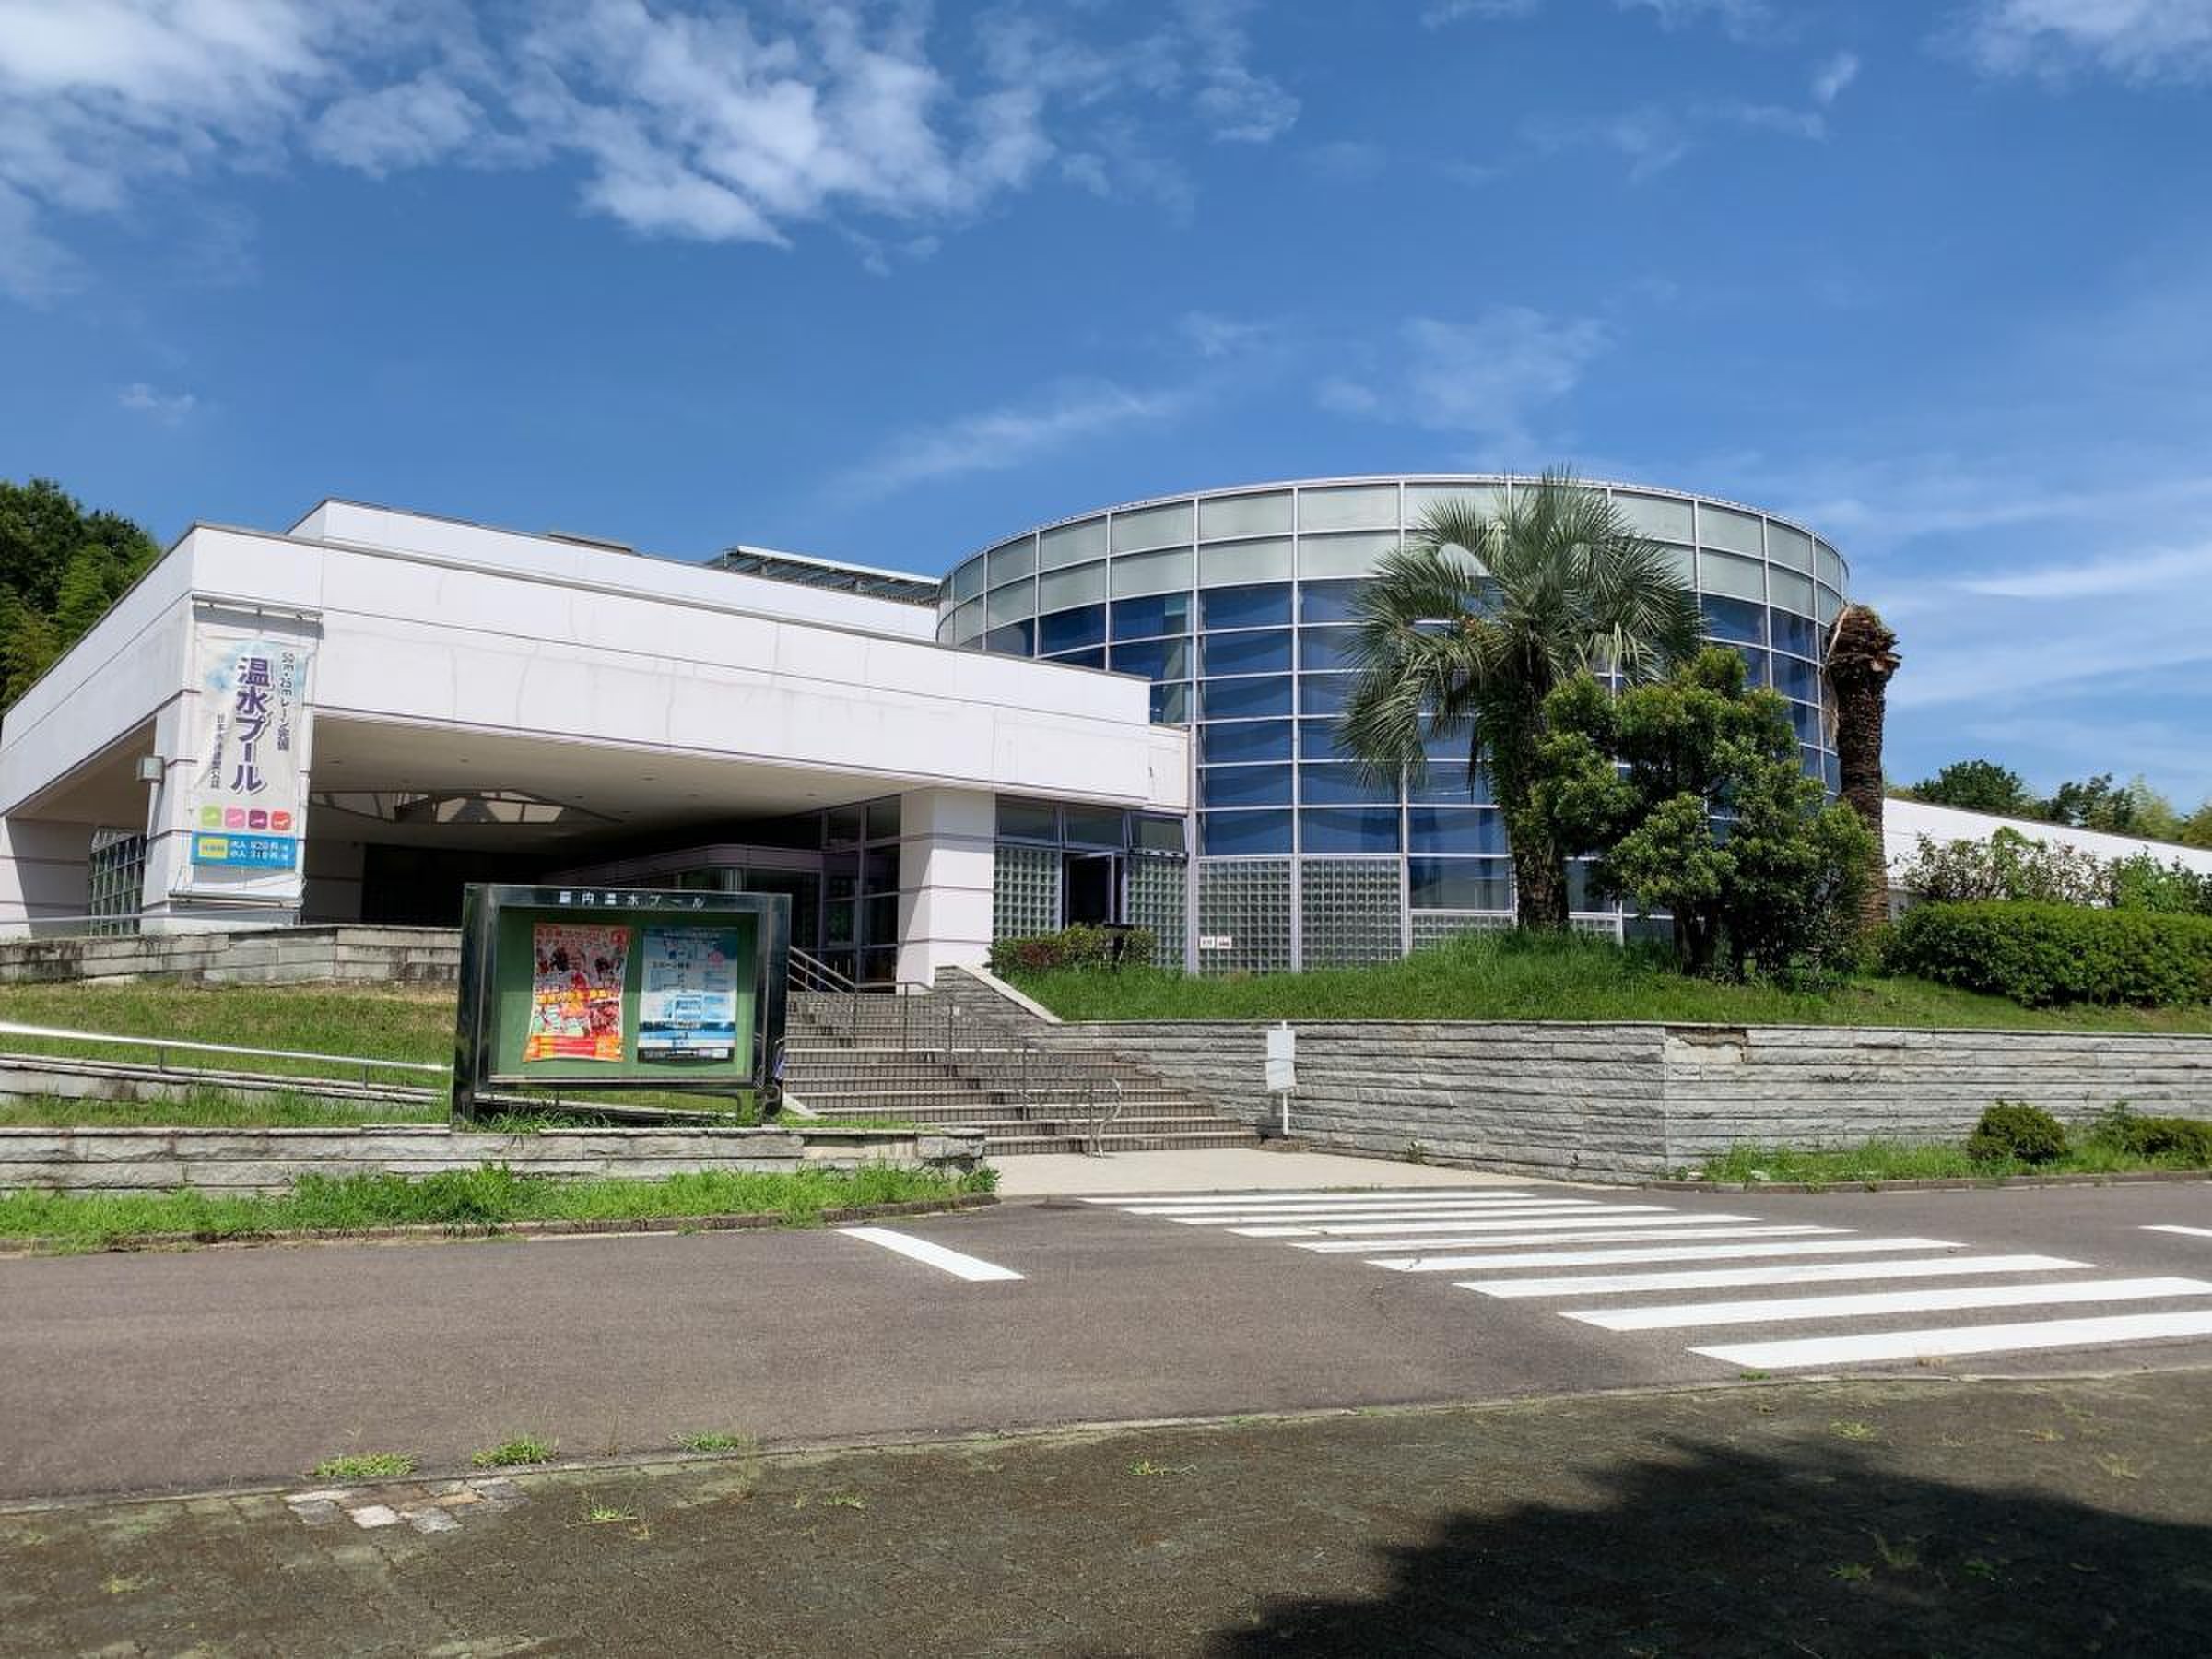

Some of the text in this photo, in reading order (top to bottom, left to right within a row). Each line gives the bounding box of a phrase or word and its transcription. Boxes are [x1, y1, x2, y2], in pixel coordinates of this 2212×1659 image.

[230, 657, 271, 792] 温水プール
